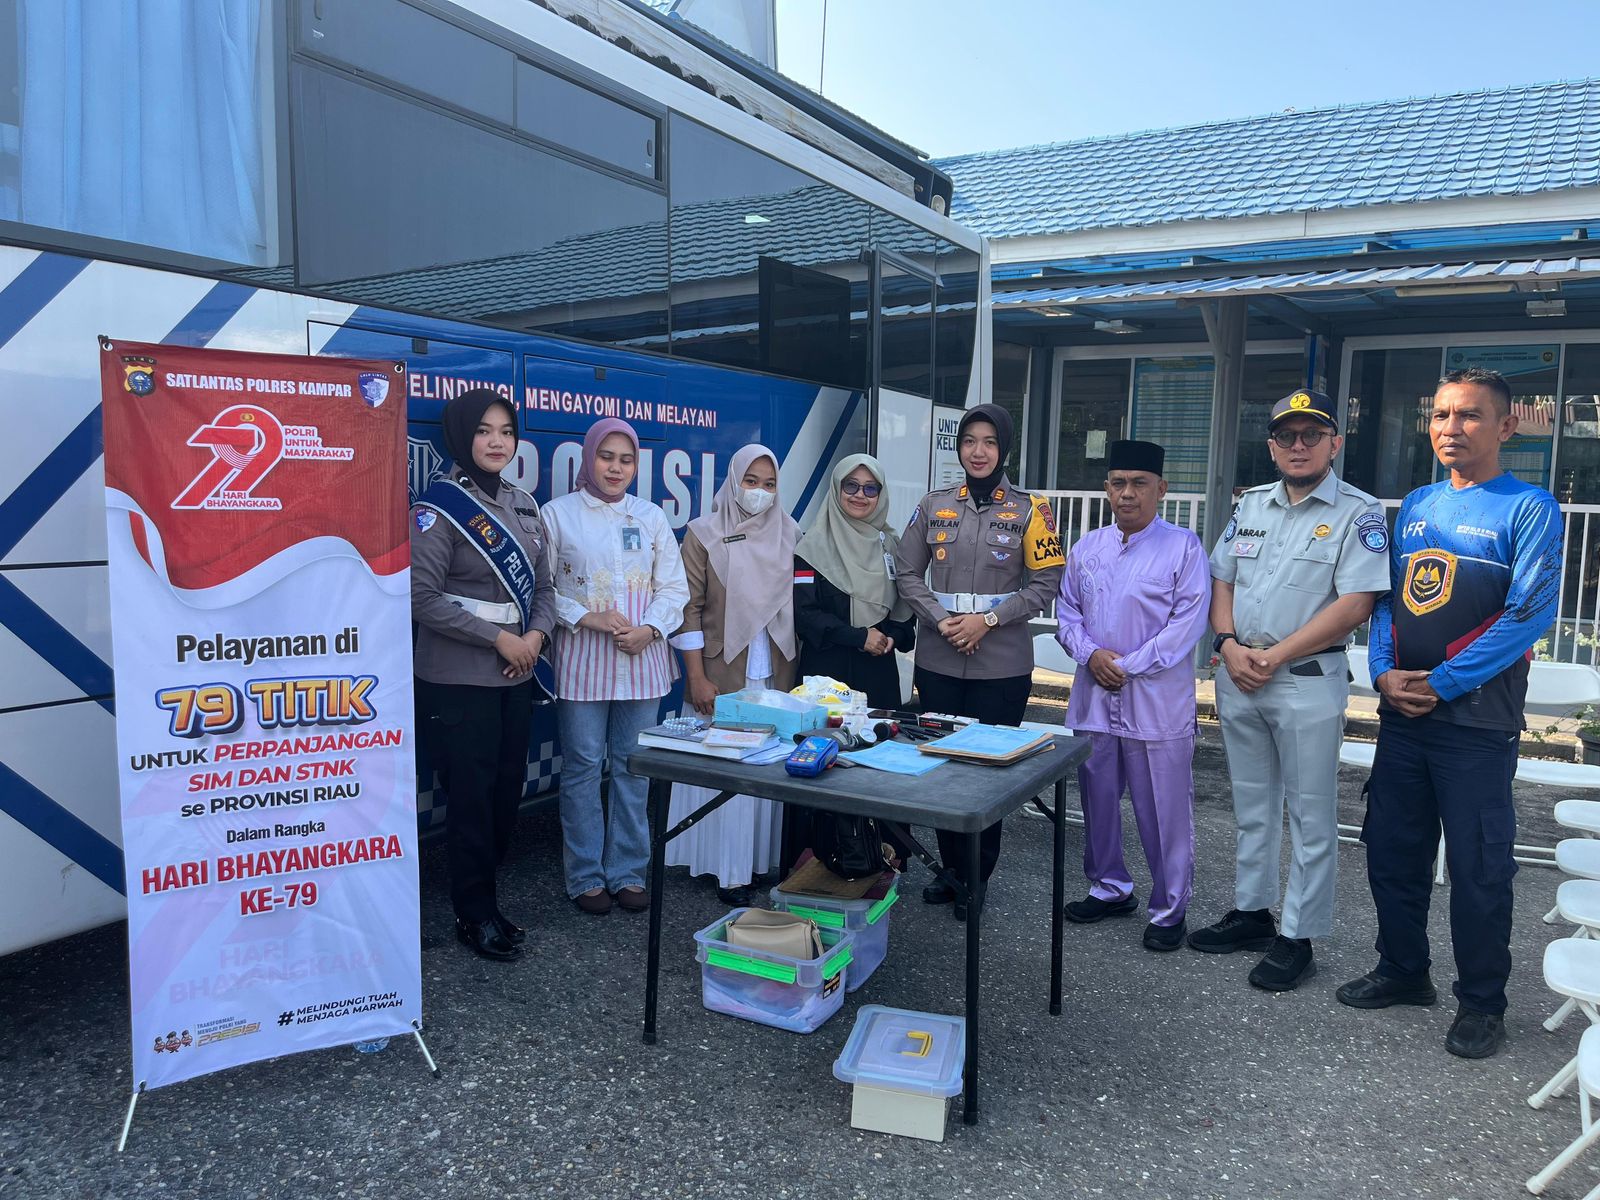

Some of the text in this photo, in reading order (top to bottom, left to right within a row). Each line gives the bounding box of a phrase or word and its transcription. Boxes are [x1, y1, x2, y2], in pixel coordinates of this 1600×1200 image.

[166, 373, 352, 397] SATLANTAS POLRES KAMPAR
[408, 373, 717, 428] ELINDGI, MENGAYOMI DAN MELAYANI
[285, 428, 315, 437] POLRI
[938, 418, 959, 434] UNIT
[285, 438, 320, 448] UNTUK
[285, 448, 353, 459] MASYARAKAT
[936, 436, 957, 452] KELI
[223, 491, 247, 500] HARI
[500, 440, 715, 529] POISI
[207, 499, 280, 508] BHAYANGKARA
[930, 519, 960, 528] WULAN
[989, 521, 1022, 534] POLRI
[1237, 528, 1267, 538] ABRAR
[1034, 547, 1062, 561] LAN
[1036, 536, 1060, 549] KAS
[503, 551, 533, 612] PELAYA
[176, 627, 359, 664] Pelayanan di
[158, 677, 375, 734] 79 TITIK
[130, 729, 402, 771] UNTUK PERPANJANGAN
[188, 759, 356, 792] SIM DAN STNK
[181, 783, 360, 817] se PROVINSI RIAU
[226, 821, 326, 843] Dalam Rangka
[142, 835, 403, 895] HARI BHAYANGKARA
[240, 882, 318, 915] KE-79
[297, 997, 366, 1015] MELINDUNGI
[368, 991, 397, 1002] TUAH
[297, 999, 403, 1025] MENJAGA MARWAH
